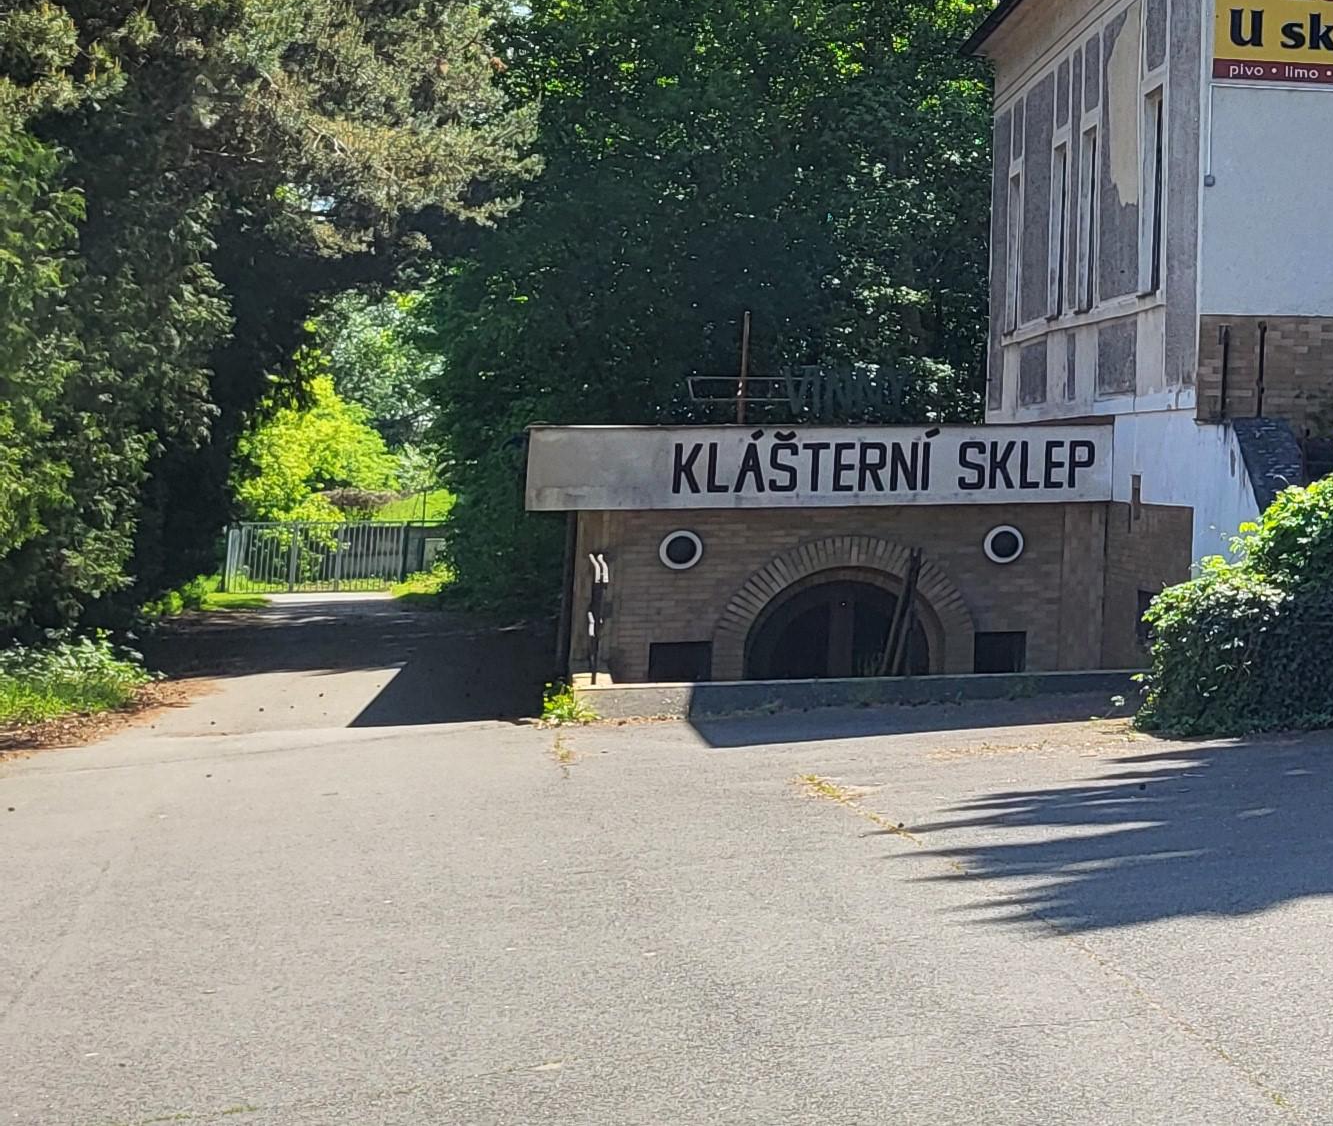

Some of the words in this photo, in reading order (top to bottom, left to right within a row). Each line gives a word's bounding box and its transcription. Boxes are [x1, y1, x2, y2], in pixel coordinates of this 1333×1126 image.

[1229, 8, 1264, 47] U
[1229, 65, 1264, 78] pivo
[1285, 64, 1319, 79] limo
[671, 427, 942, 494] KLÁŠTERNÍ
[957, 439, 1096, 490] SKLEP
